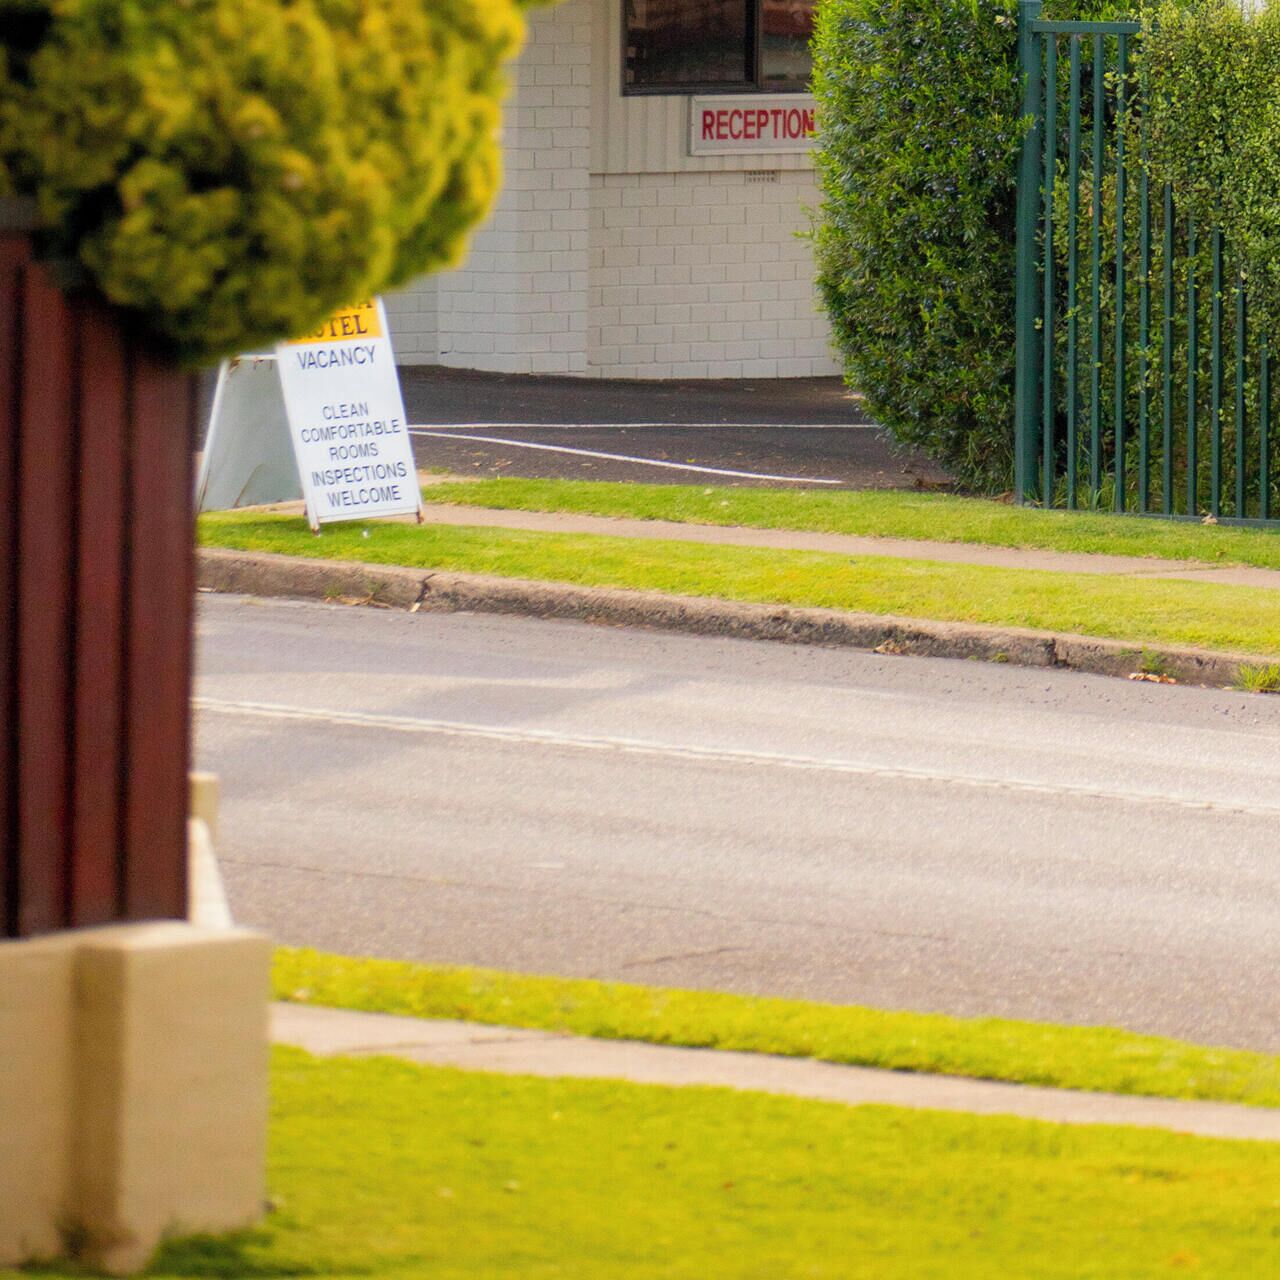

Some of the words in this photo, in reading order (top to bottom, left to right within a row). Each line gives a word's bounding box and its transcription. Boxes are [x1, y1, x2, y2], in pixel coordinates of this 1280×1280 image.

[702, 108, 816, 141] RECEPTION
[314, 315, 368, 339] TEL
[296, 344, 376, 370] VACANCY
[322, 402, 369, 420] CLEAN
[301, 419, 401, 443] COMFORTABLE
[328, 442, 379, 461] ROOMS
[311, 461, 408, 487] INSPECTIONS
[327, 485, 402, 508] WELCOME
